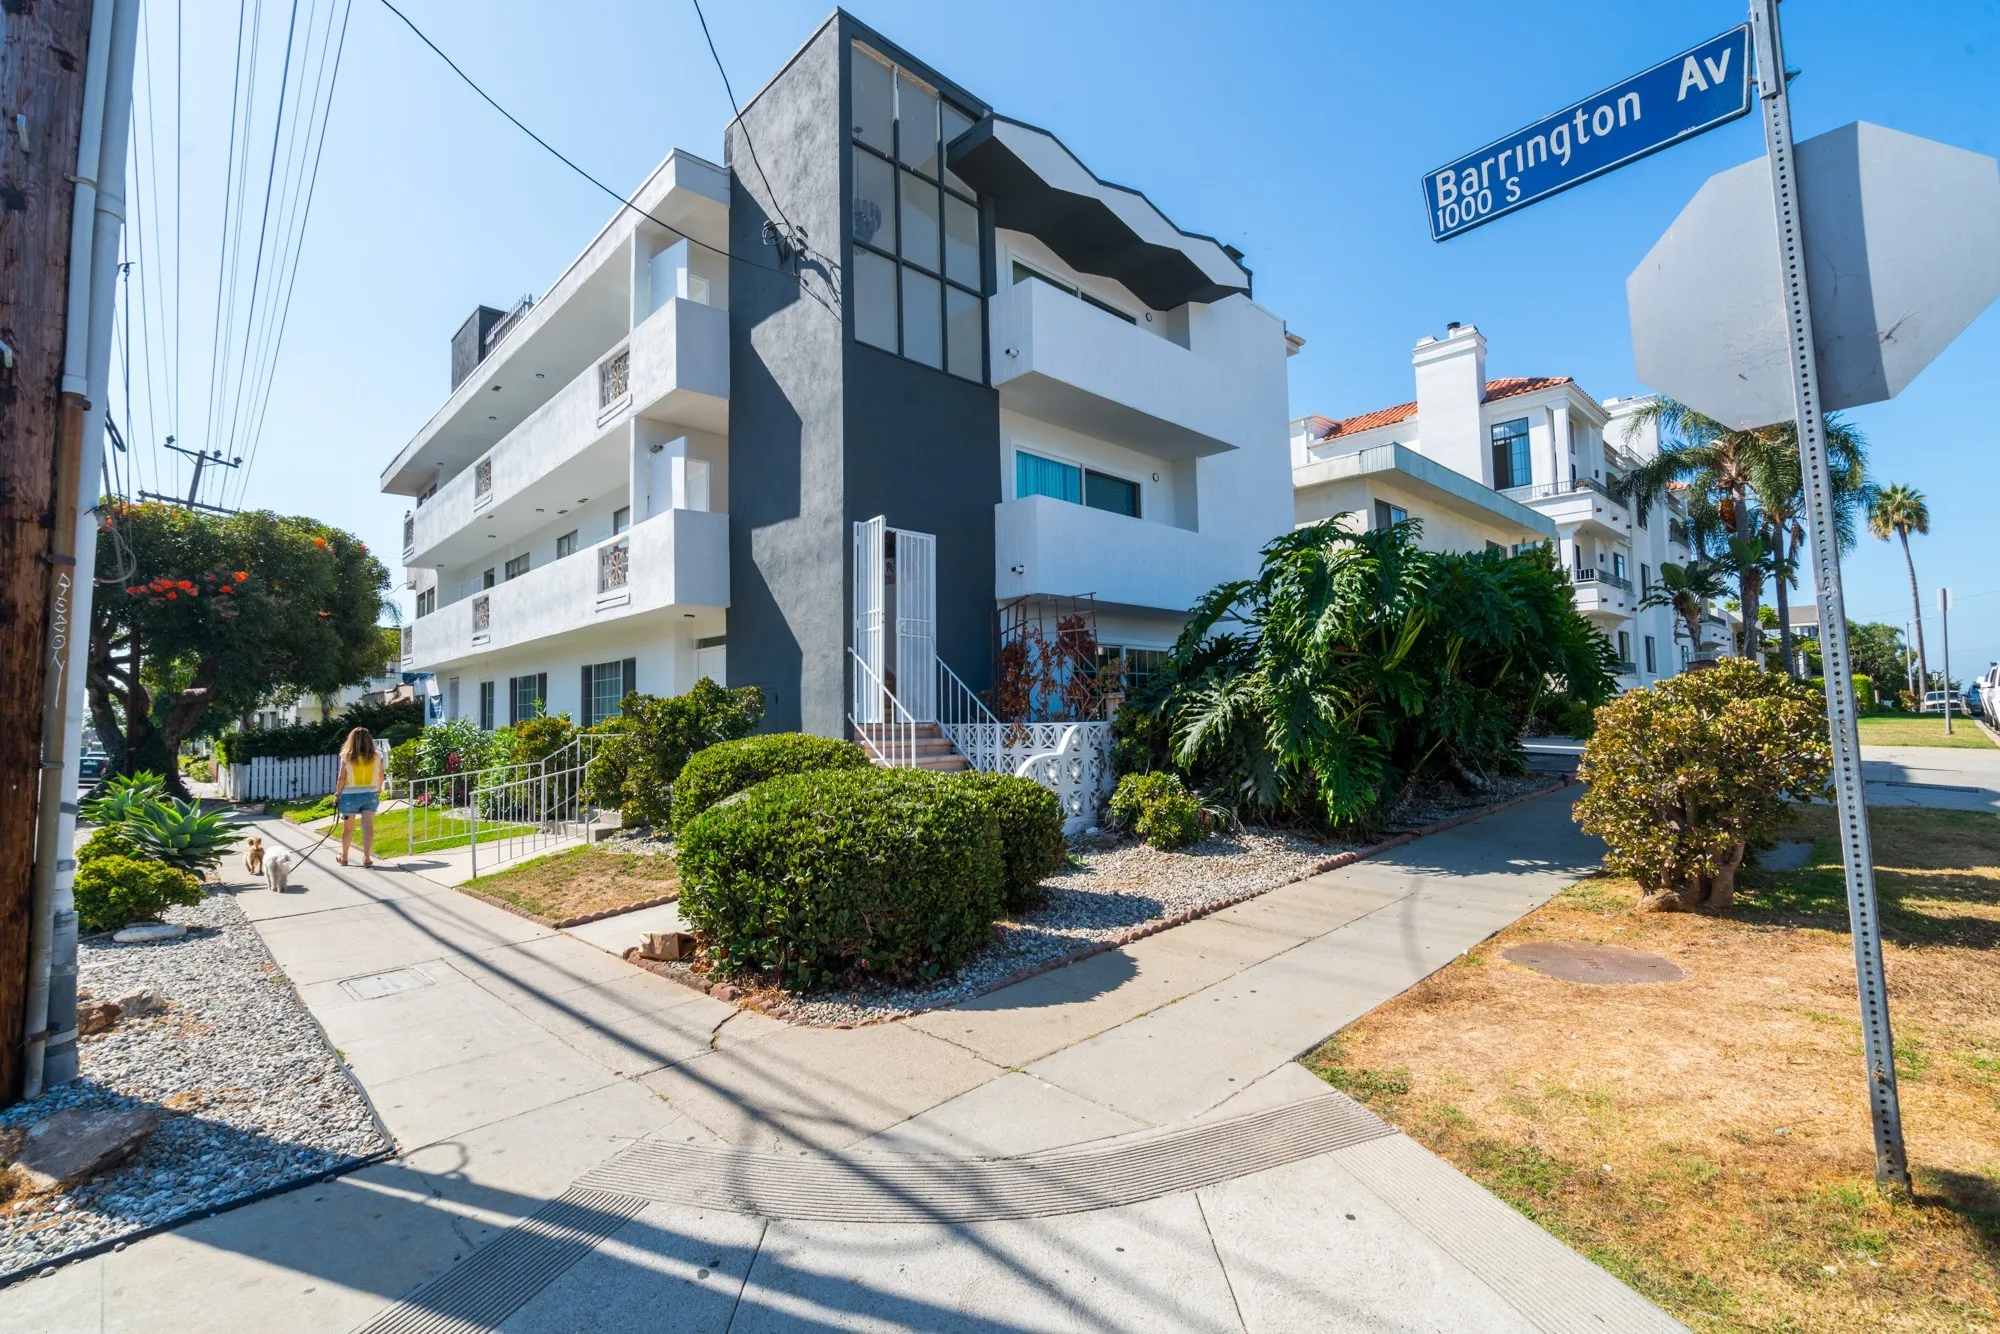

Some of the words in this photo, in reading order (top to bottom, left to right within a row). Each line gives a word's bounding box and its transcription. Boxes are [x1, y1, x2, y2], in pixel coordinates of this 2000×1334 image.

[1436, 91, 1641, 208] Barrington
[1677, 47, 1731, 102] Av
[1437, 189, 1492, 232] 1000
[1505, 176, 1521, 202] S
